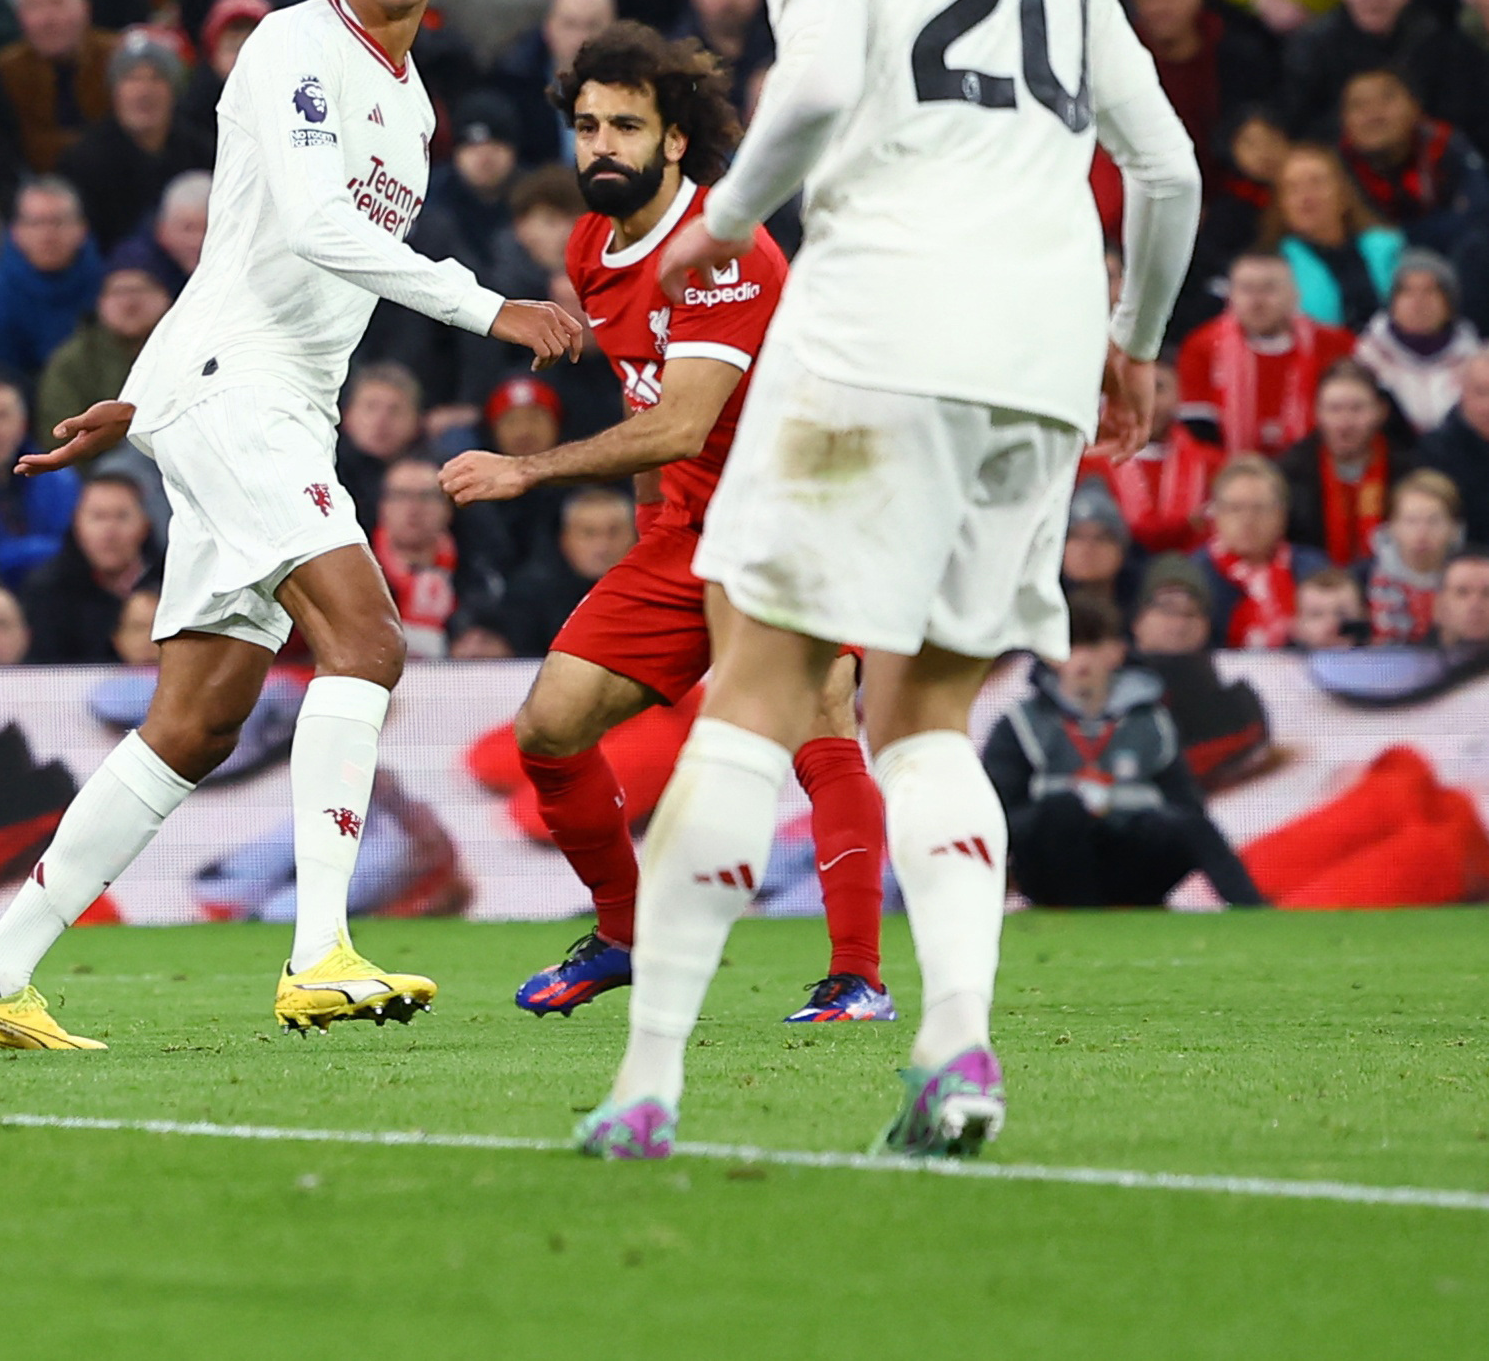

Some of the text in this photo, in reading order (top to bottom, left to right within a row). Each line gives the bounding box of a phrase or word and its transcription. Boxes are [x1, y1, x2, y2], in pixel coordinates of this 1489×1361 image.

[290, 130, 334, 142] No room
[366, 155, 413, 213] Team
[346, 177, 406, 237] iewer
[684, 281, 761, 308] Expedia
